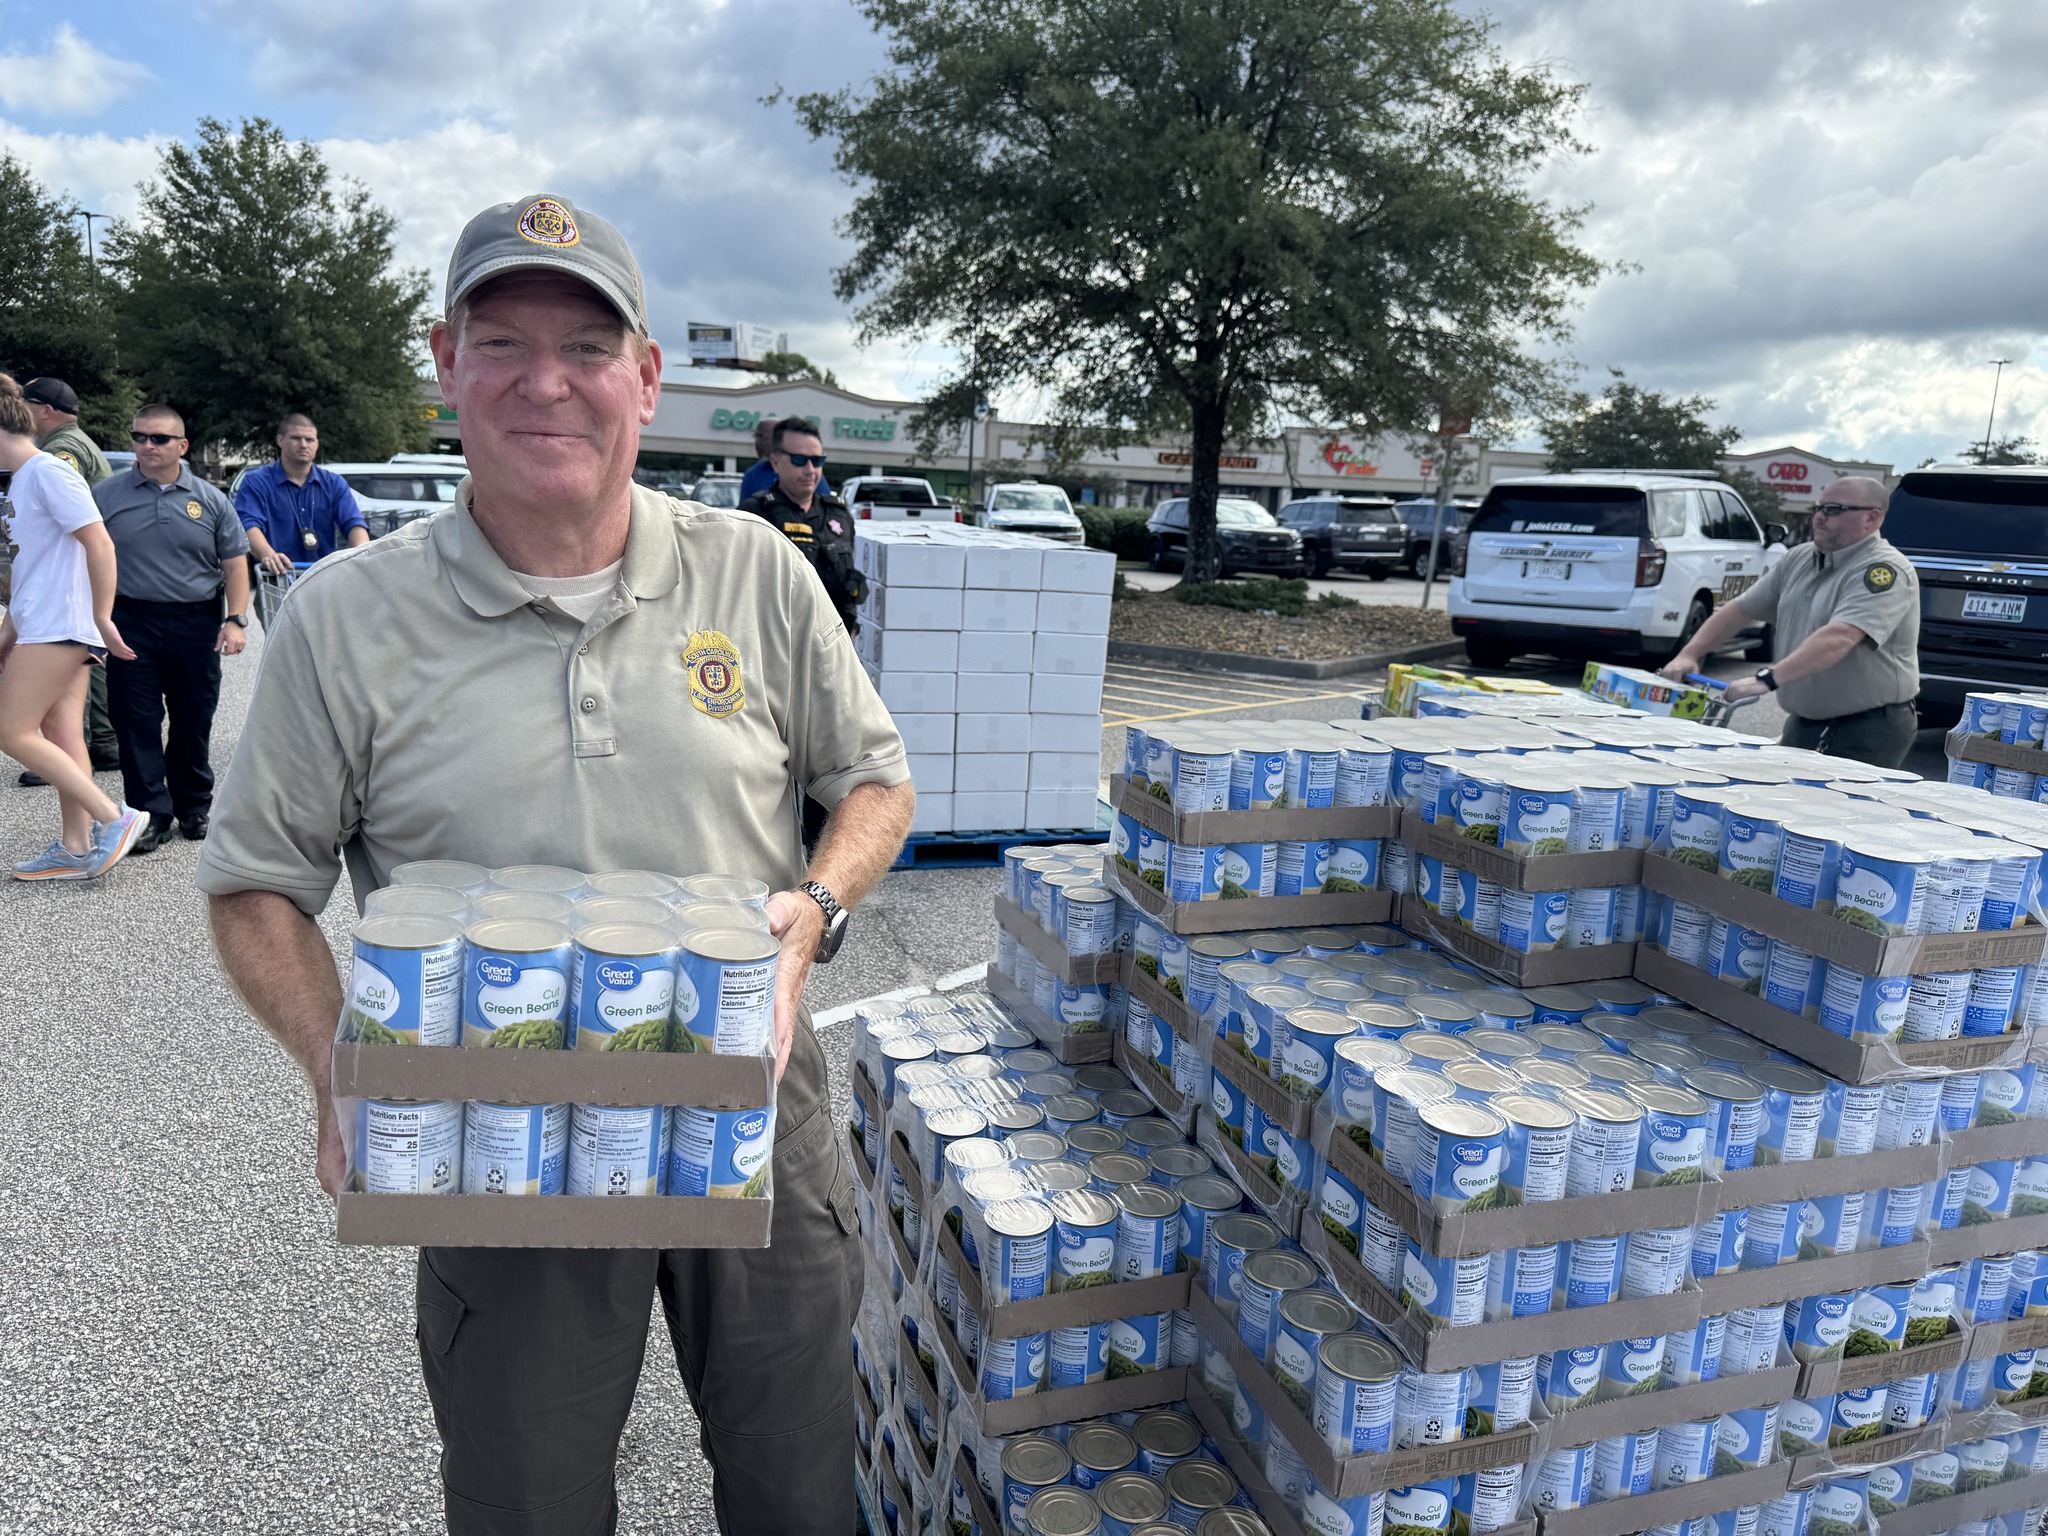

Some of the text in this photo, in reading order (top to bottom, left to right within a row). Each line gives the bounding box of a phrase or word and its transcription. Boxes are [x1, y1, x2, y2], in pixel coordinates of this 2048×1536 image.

[536, 213, 561, 221] SLED
[711, 409, 897, 440] DOLR TREE
[1768, 463, 1808, 480] CATO
[1963, 575, 2032, 585] TAHOE
[1968, 599, 1987, 611] 414
[1403, 758, 1423, 767] Great
[1462, 784, 1478, 794] Great
[1521, 799, 1544, 808] Great
[1462, 809, 1483, 820] Green
[1522, 824, 1549, 833] Green
[1704, 829, 1720, 838] Cut
[1731, 823, 1751, 836] Great
[1735, 831, 1750, 840] Value
[1692, 836, 1718, 846] Beans
[1730, 851, 1755, 863] Green
[1231, 863, 1243, 872] Cut
[1340, 866, 1361, 875] Beans
[1868, 889, 1886, 900] Cut
[1548, 900, 1565, 909] Great
[1854, 895, 1885, 909] Beans
[1742, 933, 1767, 943] Great
[425, 953, 452, 965] Nutrition
[481, 962, 512, 976] Great
[601, 967, 634, 980] Great
[724, 968, 767, 978] Nutrition Facts
[488, 972, 512, 983] Value
[609, 977, 634, 986] Value
[366, 985, 386, 999] Cut
[425, 985, 448, 995] Calories
[543, 987, 560, 1000] Cut
[1881, 984, 1904, 995] Great
[757, 994, 764, 1003] 25
[484, 999, 559, 1015] Green Beans
[604, 1005, 643, 1017] Green
[1063, 1008, 1082, 1017] Green
[1303, 1059, 1320, 1070] Cut
[1293, 1063, 1319, 1078] Beans
[1344, 1071, 1366, 1082] Great
[2000, 1085, 2016, 1093] Cut
[1985, 1090, 2014, 1101] Beans
[1895, 1104, 1904, 1112] 25
[369, 1108, 396, 1120] Nutrition
[584, 1109, 598, 1120] Facts
[738, 1117, 763, 1131] Great
[1655, 1122, 1681, 1133] Great
[744, 1126, 762, 1136] Value
[1590, 1124, 1607, 1135] Facts
[1661, 1129, 1681, 1139] Value
[1531, 1134, 1555, 1142] Nutrition
[369, 1139, 417, 1149] Calories 25
[588, 1140, 596, 1149] 25
[1456, 1146, 1484, 1157] Great
[1594, 1149, 1604, 1157] 25
[740, 1150, 766, 1166] Green
[1463, 1154, 1483, 1162] Value
[1655, 1152, 1685, 1162] Green
[1459, 1177, 1488, 1187] Green
[1974, 1182, 1991, 1192] Cut
[1335, 1198, 1351, 1211] Cut
[1060, 1231, 1080, 1243] Great
[1657, 1233, 1672, 1241] Facts
[1388, 1240, 1397, 1248] 25
[1099, 1248, 1112, 1258] Cut
[1062, 1256, 1110, 1268] Green Beans
[1458, 1263, 1475, 1272] Nutrition
[1821, 1301, 1844, 1313] Great
[1872, 1311, 1889, 1322] Cut
[1124, 1337, 1138, 1345] Cut
[1633, 1342, 1652, 1350] Value
[1114, 1341, 1137, 1353] Beans
[1573, 1349, 1595, 1360] Great
[1290, 1354, 1306, 1366] Cut
[1503, 1361, 1523, 1371] Nutrition
[1628, 1362, 1654, 1372] Green
[2010, 1373, 2031, 1381] Green
[1843, 1409, 1870, 1420] Green
[1800, 1416, 1816, 1425] Cut
[1787, 1421, 1814, 1432] Beans
[1723, 1429, 1741, 1440] Cut
[1929, 1469, 1954, 1479] Beans
[1879, 1477, 1895, 1486] Cut
[1868, 1481, 1894, 1493] Beans
[1010, 1487, 1030, 1500] Great
[1427, 1503, 1442, 1512] Cut
[1843, 1502, 1858, 1511] Cut
[1385, 1502, 1441, 1522] Green Beans
[1831, 1507, 1856, 1517] Beans
[1327, 1515, 1344, 1526] Cut
[1312, 1517, 1343, 1536] Beans
